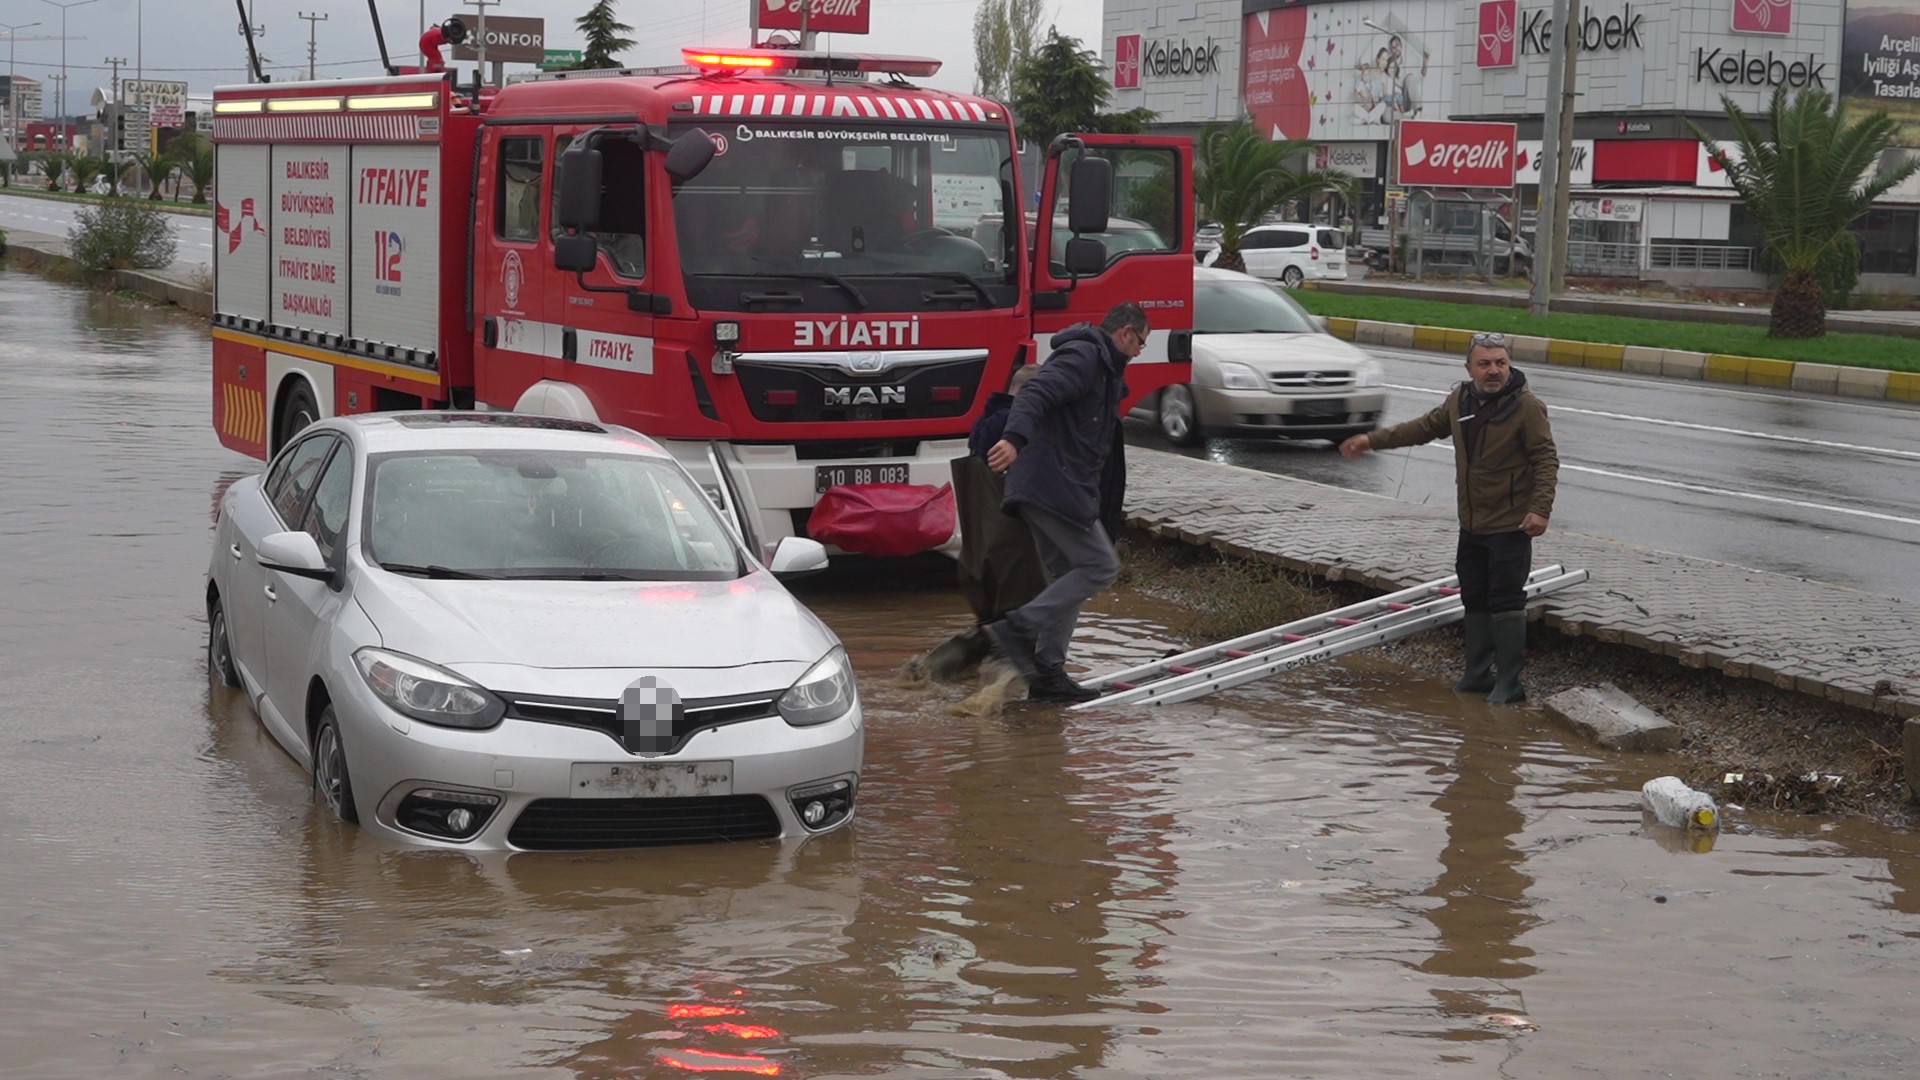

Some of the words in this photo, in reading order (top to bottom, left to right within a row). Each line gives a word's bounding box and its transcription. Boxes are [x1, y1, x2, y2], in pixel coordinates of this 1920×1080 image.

[788, 0, 860, 18] açelik
[1521, 3, 1642, 54] Kebek
[1143, 36, 1220, 76] Kelebek
[1696, 47, 1826, 89] Kelebek
[755, 129, 815, 139] BALIKESİR
[817, 129, 888, 141] BÜYÜKŞEHİR
[890, 131, 950, 143] BELEDİYESİ
[286, 158, 330, 180] BALIKESİR
[1329, 148, 1368, 166] Kelebek
[1429, 140, 1509, 174] arçelik
[359, 168, 430, 208] İTFAİYE
[281, 191, 335, 218] BÜYÜKŞEHİR
[284, 225, 331, 249] BELEDİYESİ
[374, 230, 403, 283] 112
[279, 256, 309, 281] İTFAİYE
[310, 260, 336, 284] DAİRE
[282, 293, 332, 317] BAŞKANLIĞI
[823, 385, 906, 406] MAN
[829, 469, 845, 486] 10
[855, 469, 872, 485] BB
[880, 467, 905, 484] 083
